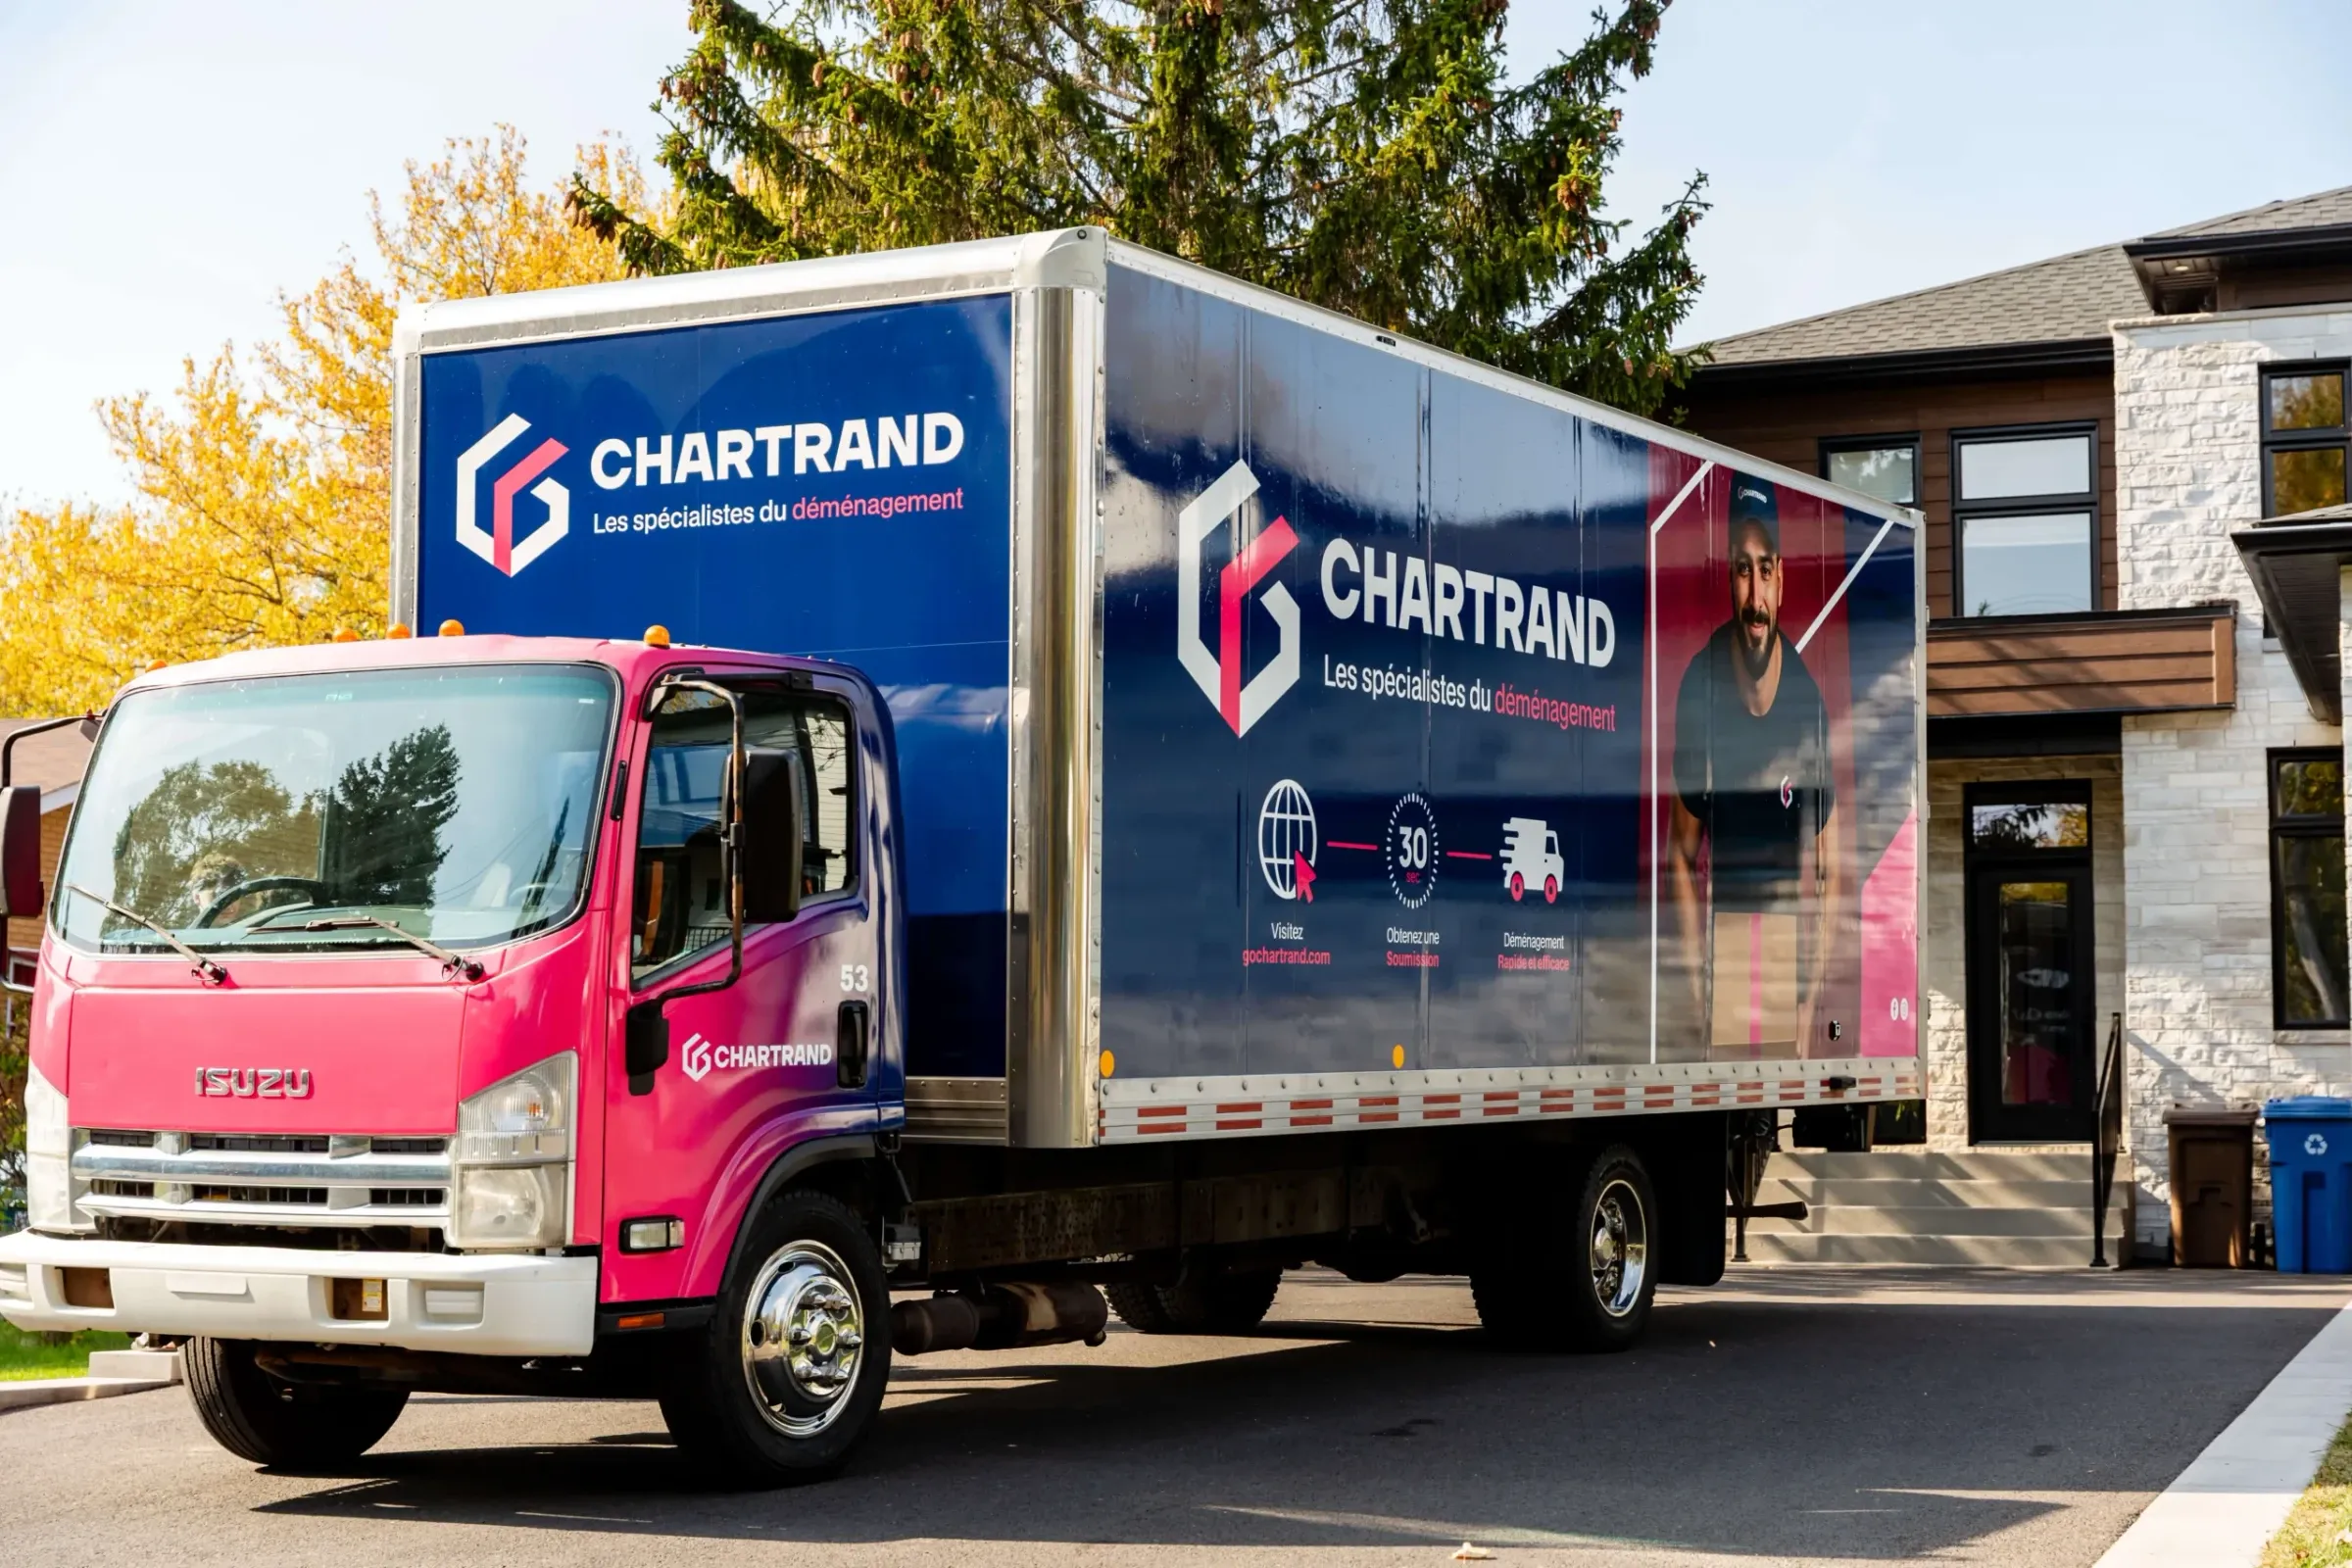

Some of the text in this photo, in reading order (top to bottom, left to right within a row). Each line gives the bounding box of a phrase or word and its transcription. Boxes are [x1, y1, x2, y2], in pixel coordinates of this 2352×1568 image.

[590, 412, 965, 490] CHARTRAND
[593, 488, 963, 535] Les spécialistes du déménagement
[1321, 538, 1616, 668] CHARTRAND
[1324, 655, 1616, 732] Les spécialistes du déménagement
[1398, 826, 1428, 869] 30
[1270, 921, 1304, 940] Visitez
[1386, 926, 1440, 945] Obtenez une
[1503, 931, 1565, 952] Déménagement
[1242, 946, 1331, 967] gochartrand.com
[1386, 950, 1440, 967] Soumission
[840, 964, 869, 992] 53
[713, 1044, 832, 1069] CHARTRAND
[195, 1066, 311, 1098] ISUZU
